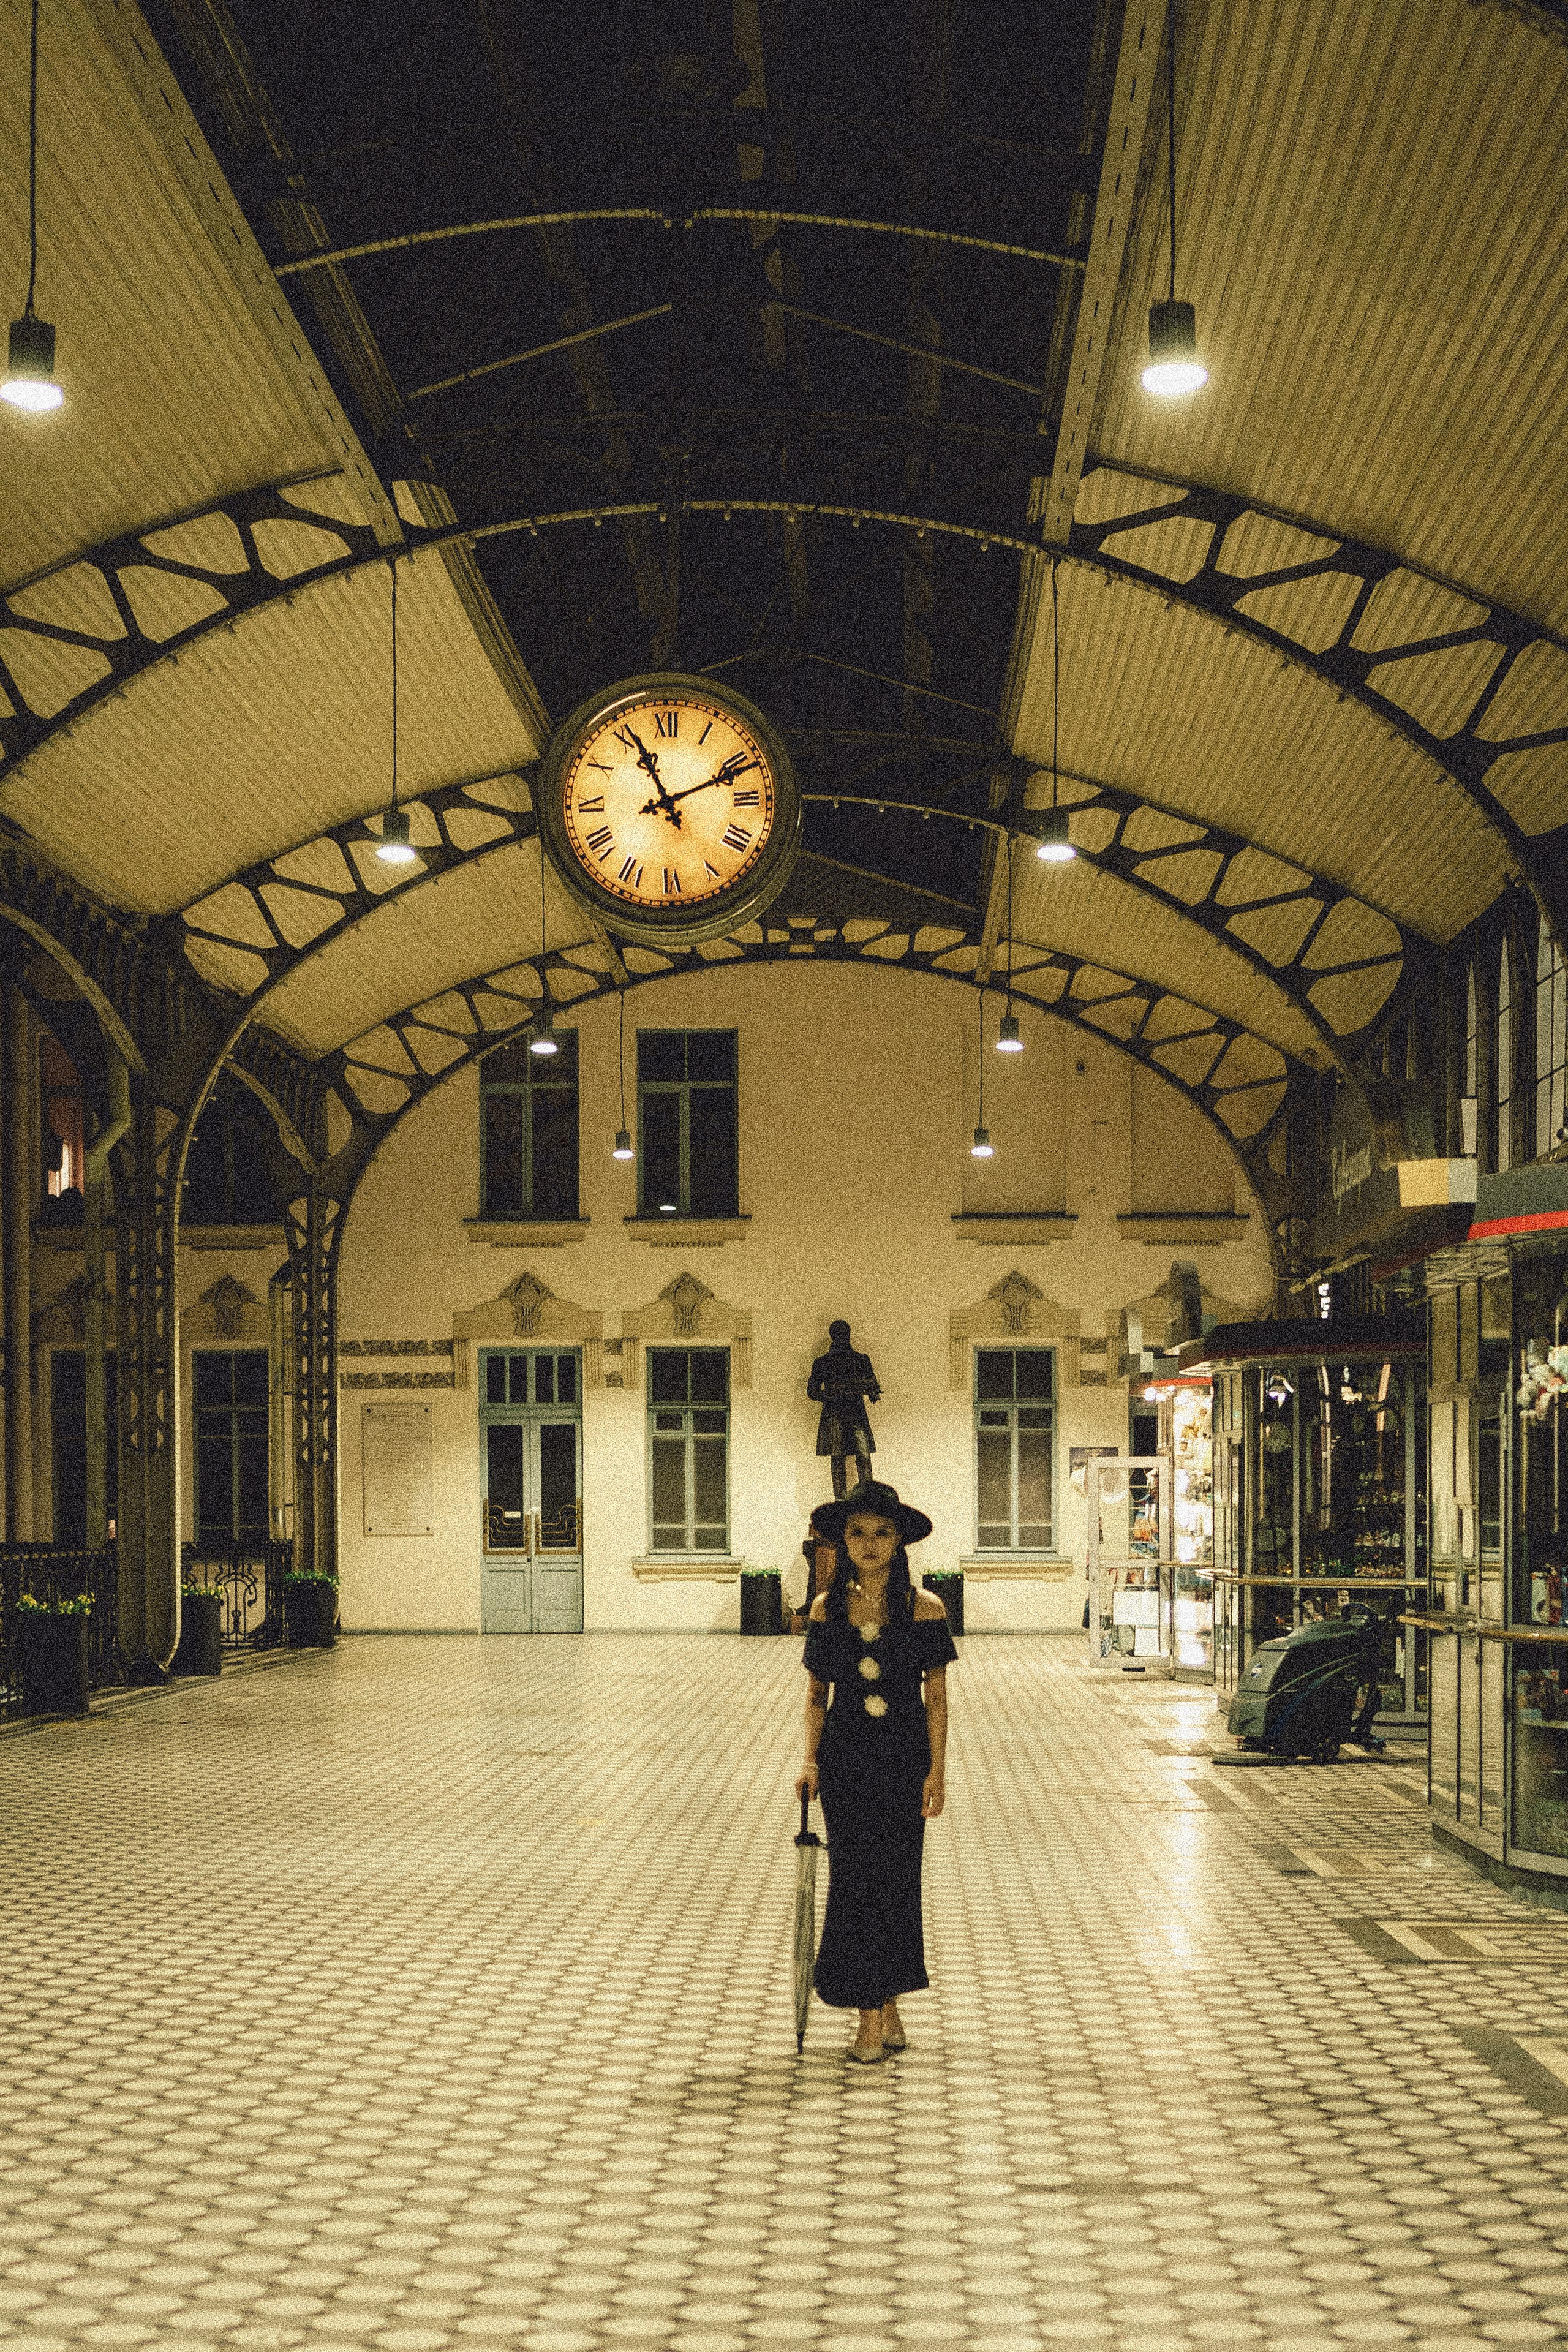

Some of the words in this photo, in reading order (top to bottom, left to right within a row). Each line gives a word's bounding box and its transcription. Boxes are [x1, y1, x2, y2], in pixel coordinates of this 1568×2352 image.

[654, 711, 678, 739] XII
[699, 721, 713, 745] I
[587, 755, 614, 778] X
[722, 751, 748, 769] II
[578, 794, 605, 813] IX
[733, 790, 760, 807] III
[586, 825, 616, 862] VIII
[722, 823, 752, 854] IIII
[618, 856, 644, 888] VII
[663, 867, 682, 894] VI
[703, 859, 720, 883] V
